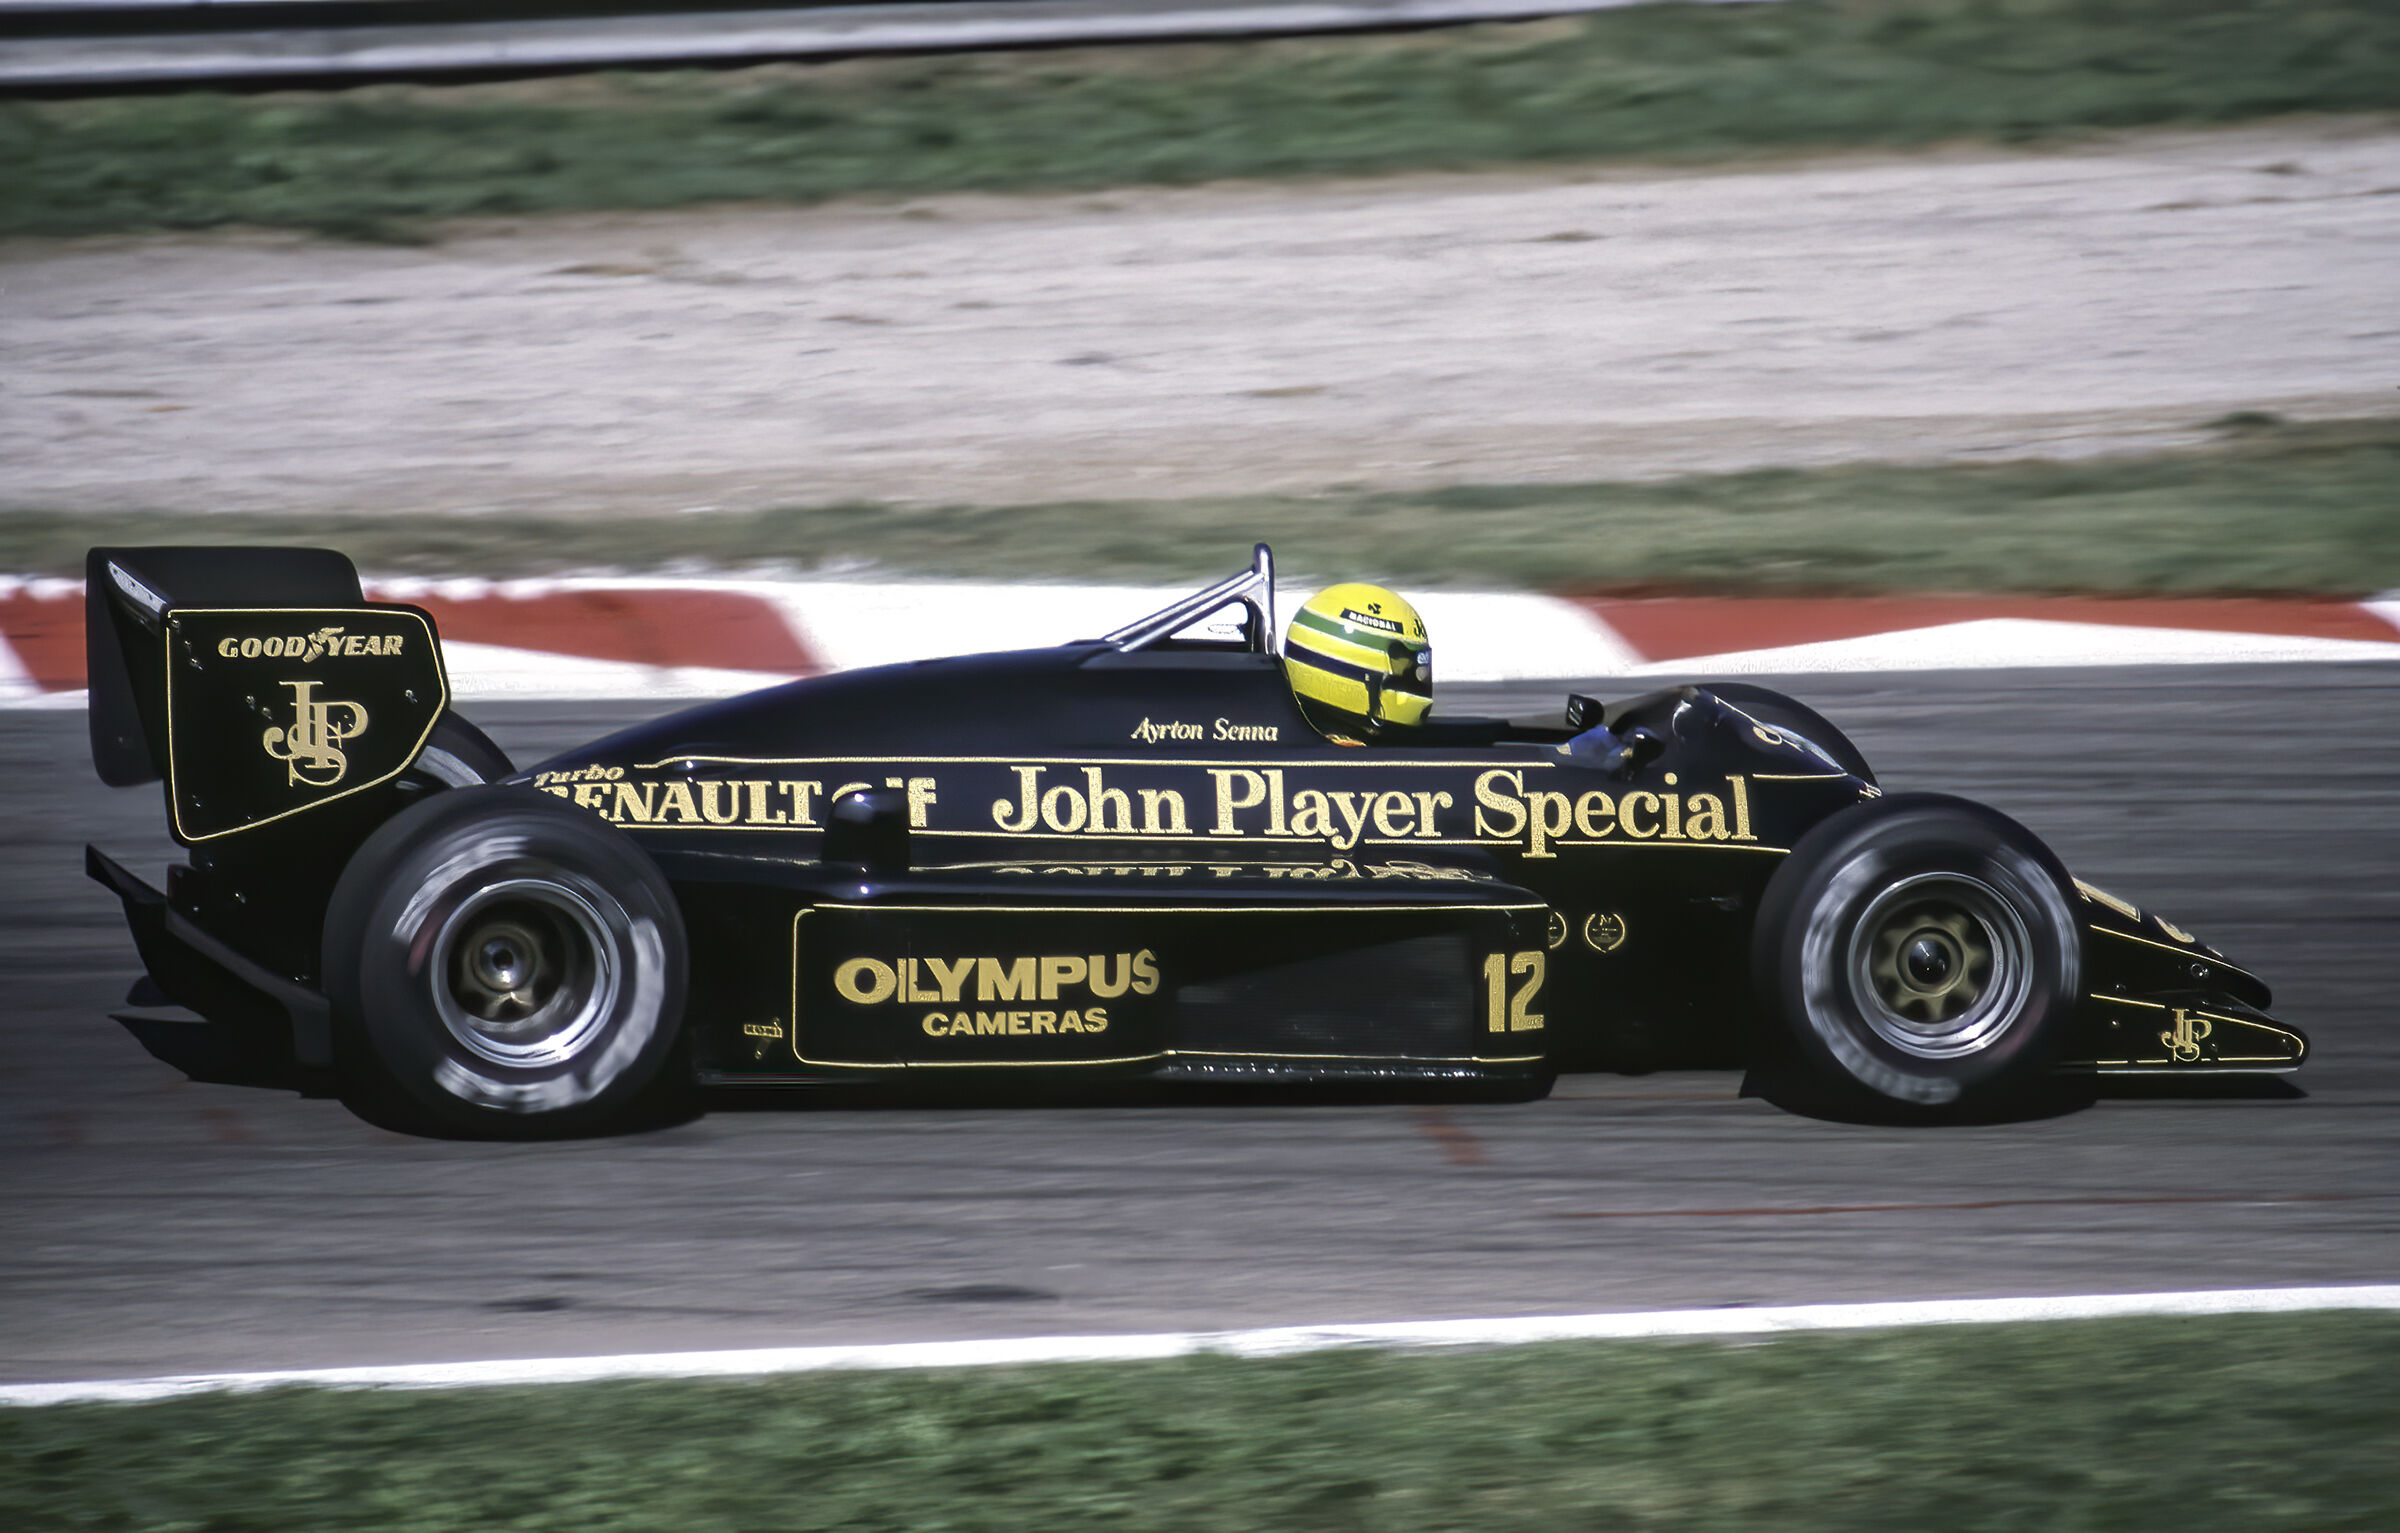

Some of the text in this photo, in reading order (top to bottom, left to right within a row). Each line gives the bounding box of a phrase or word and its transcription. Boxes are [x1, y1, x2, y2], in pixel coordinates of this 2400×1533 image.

[1131, 717, 1279, 744] Ayrton Senna
[533, 763, 625, 788] Turbo
[992, 765, 1194, 834] John
[1207, 768, 1453, 850] Player
[1474, 769, 1758, 858] Special
[834, 949, 1160, 1005] OLYMPUS
[1484, 950, 1545, 1033] 12
[922, 1007, 1109, 1037] CAMERAS
